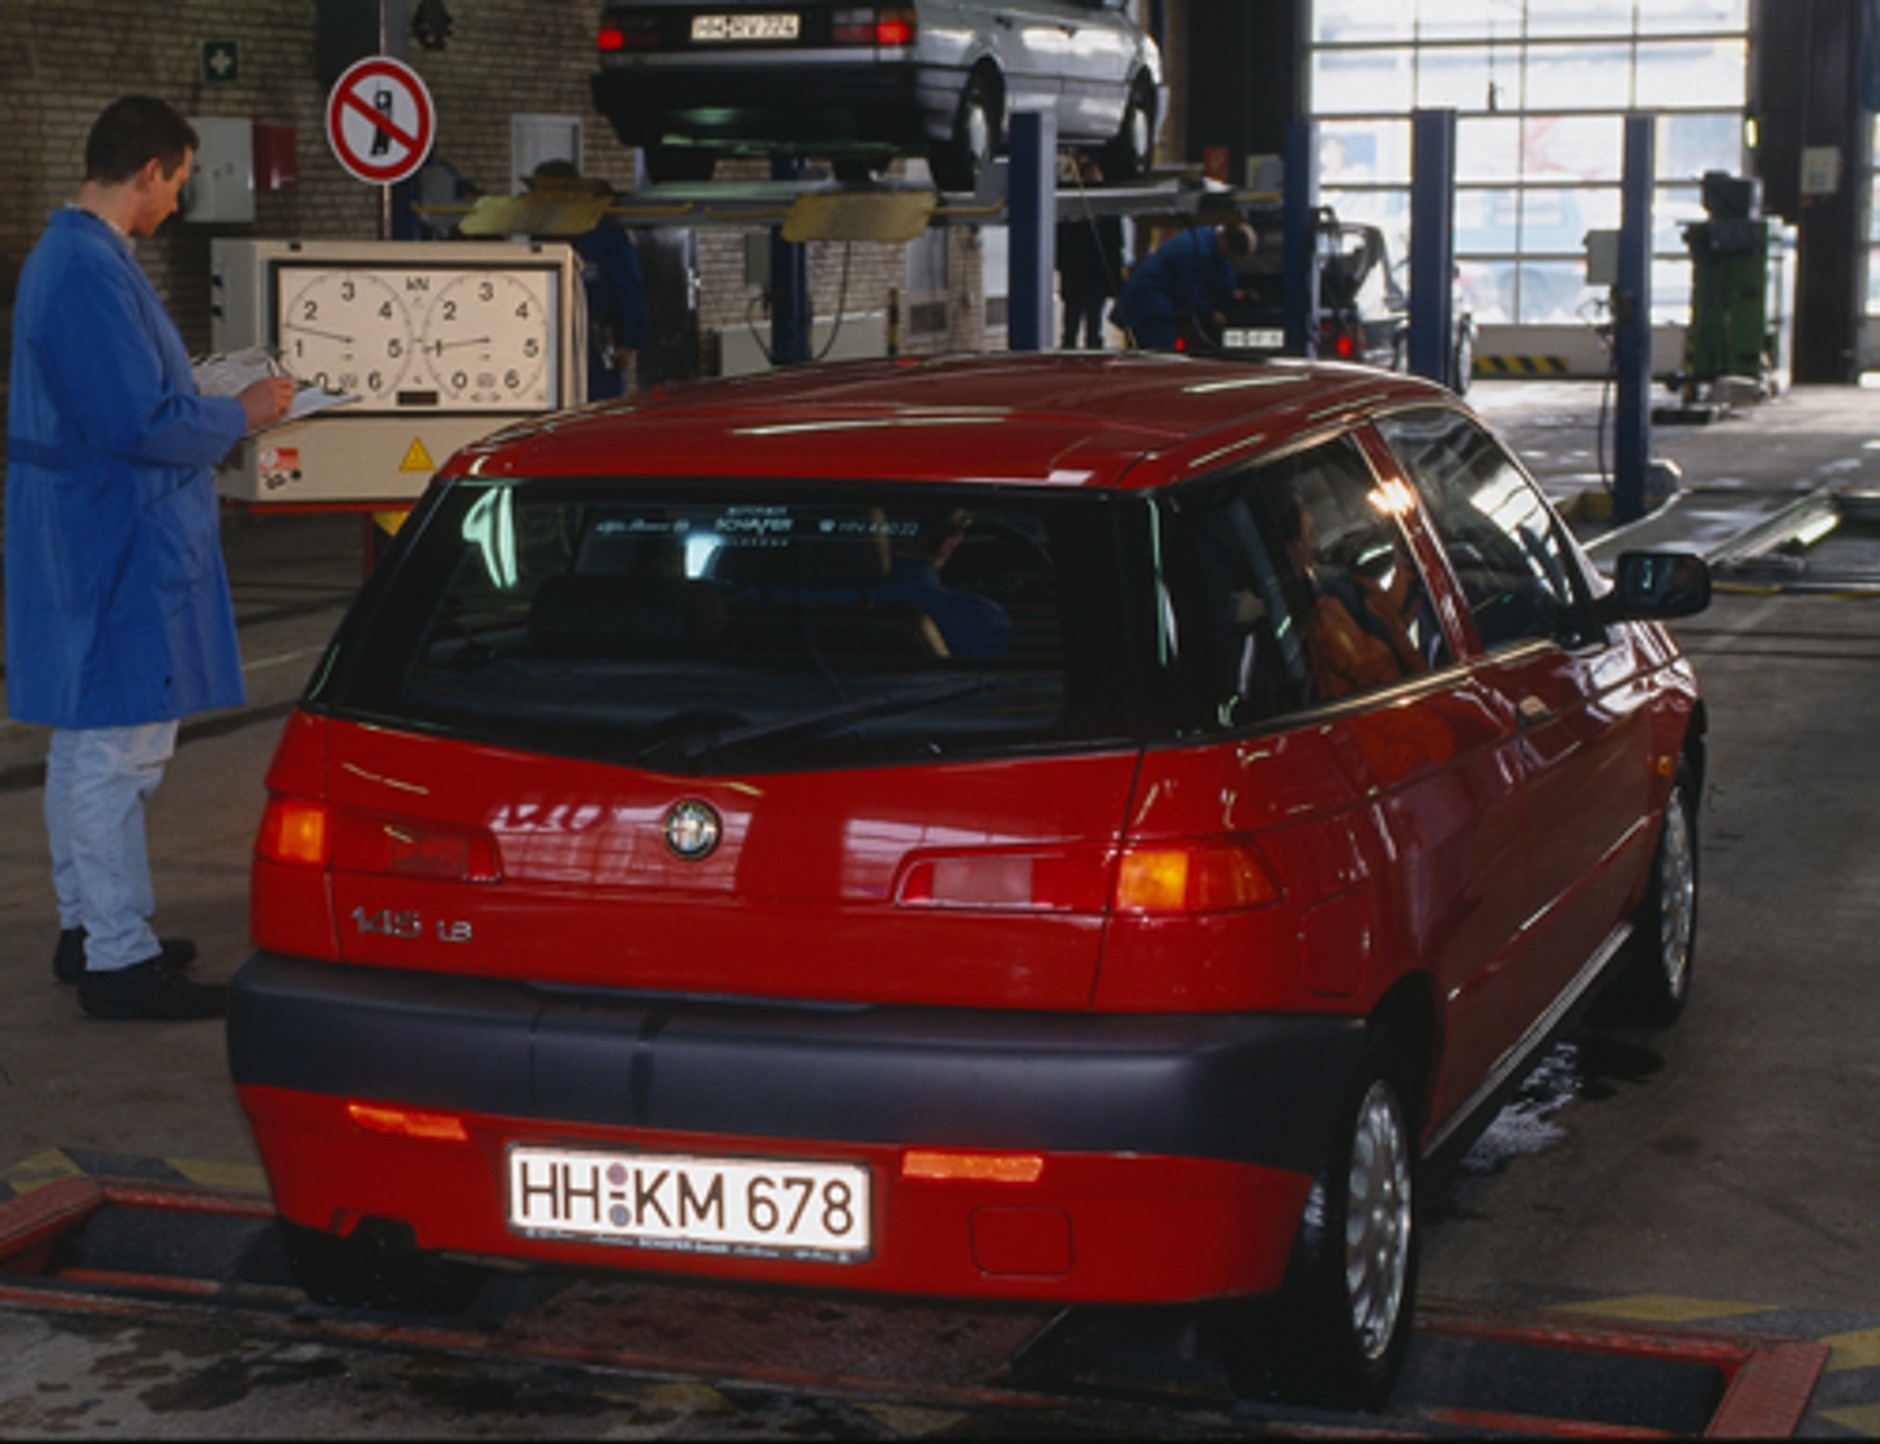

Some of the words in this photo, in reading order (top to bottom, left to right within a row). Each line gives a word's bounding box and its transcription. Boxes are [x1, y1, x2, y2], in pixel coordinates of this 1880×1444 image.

[341, 281, 356, 301] 3
[479, 282, 494, 301] 3
[304, 301, 318, 320] 2
[379, 302, 393, 319] 4
[443, 301, 457, 320] 2
[515, 302, 529, 320] 4
[387, 339, 403, 358] 5
[524, 338, 539, 358] 5
[368, 371, 382, 391] 6
[451, 371, 468, 389] 0
[504, 369, 520, 389] 6
[352, 906, 422, 938] 145
[747, 1175, 854, 1236] 678
